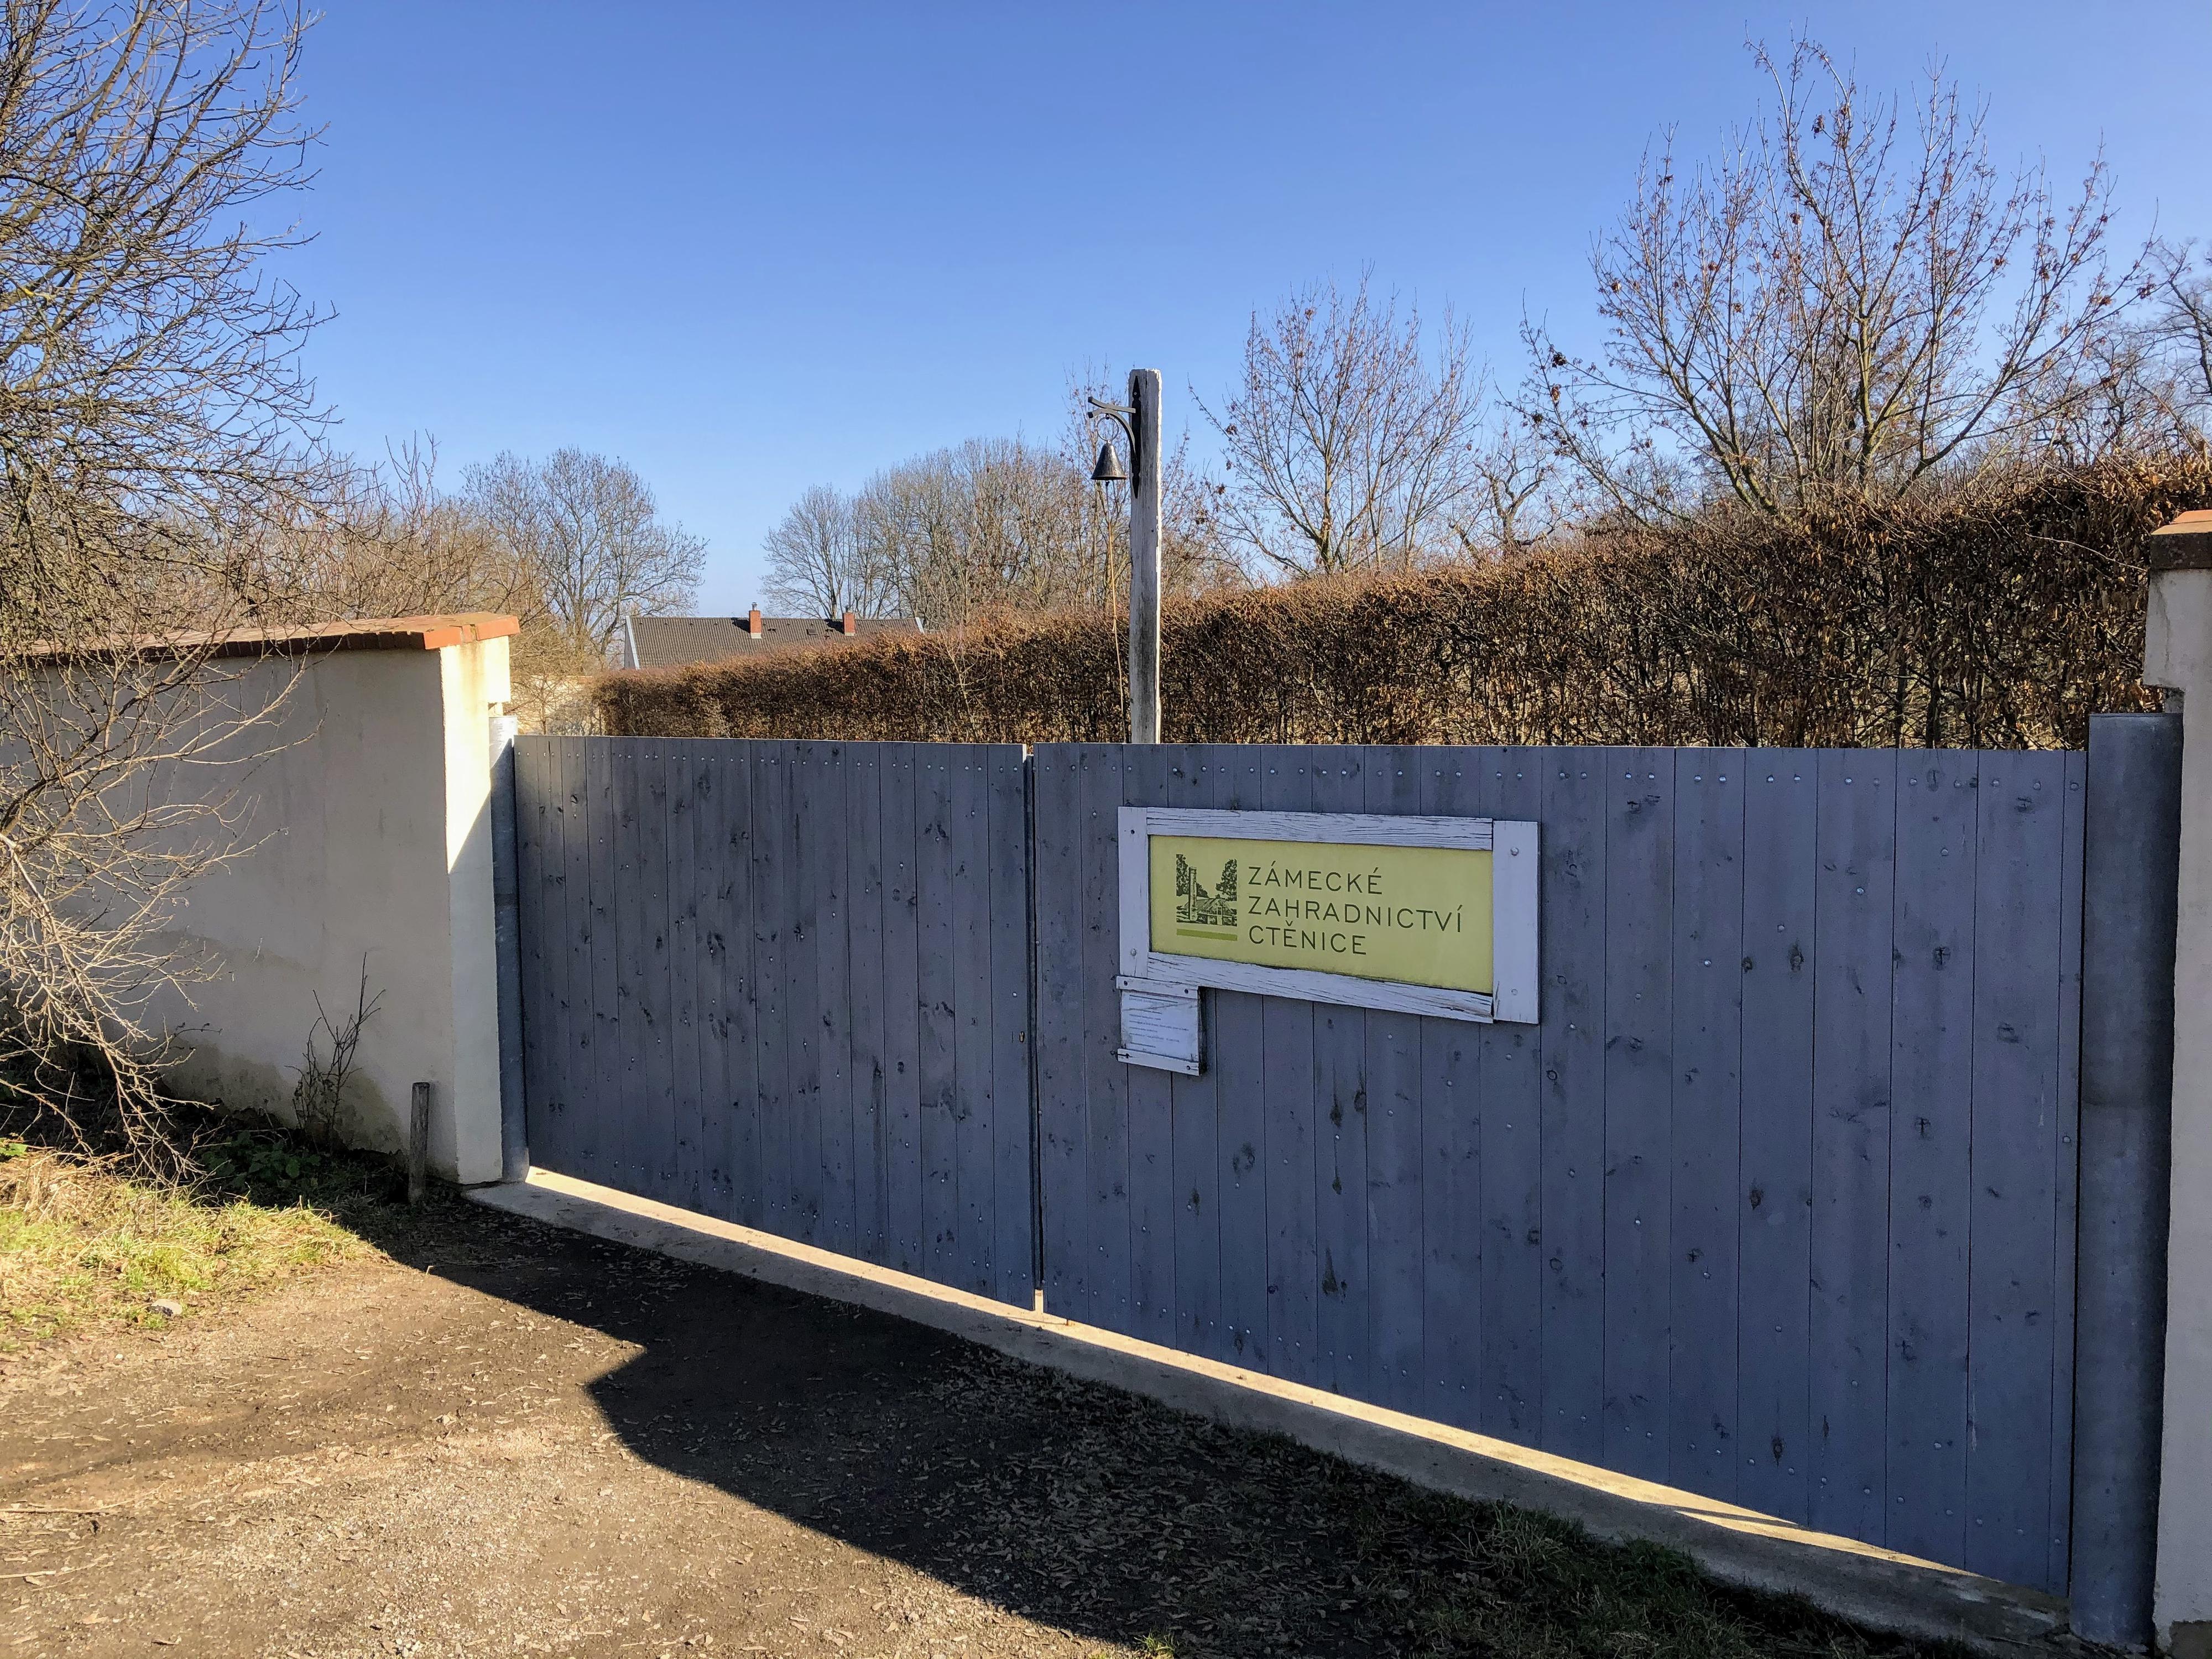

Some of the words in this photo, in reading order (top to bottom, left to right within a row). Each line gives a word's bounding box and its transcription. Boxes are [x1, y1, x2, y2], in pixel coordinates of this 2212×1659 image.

[1248, 860, 1383, 895] ZÁMECKÉ
[1248, 895, 1463, 933] ZAHRADNICTVÍ
[1249, 920, 1366, 955] CTĚNICE
